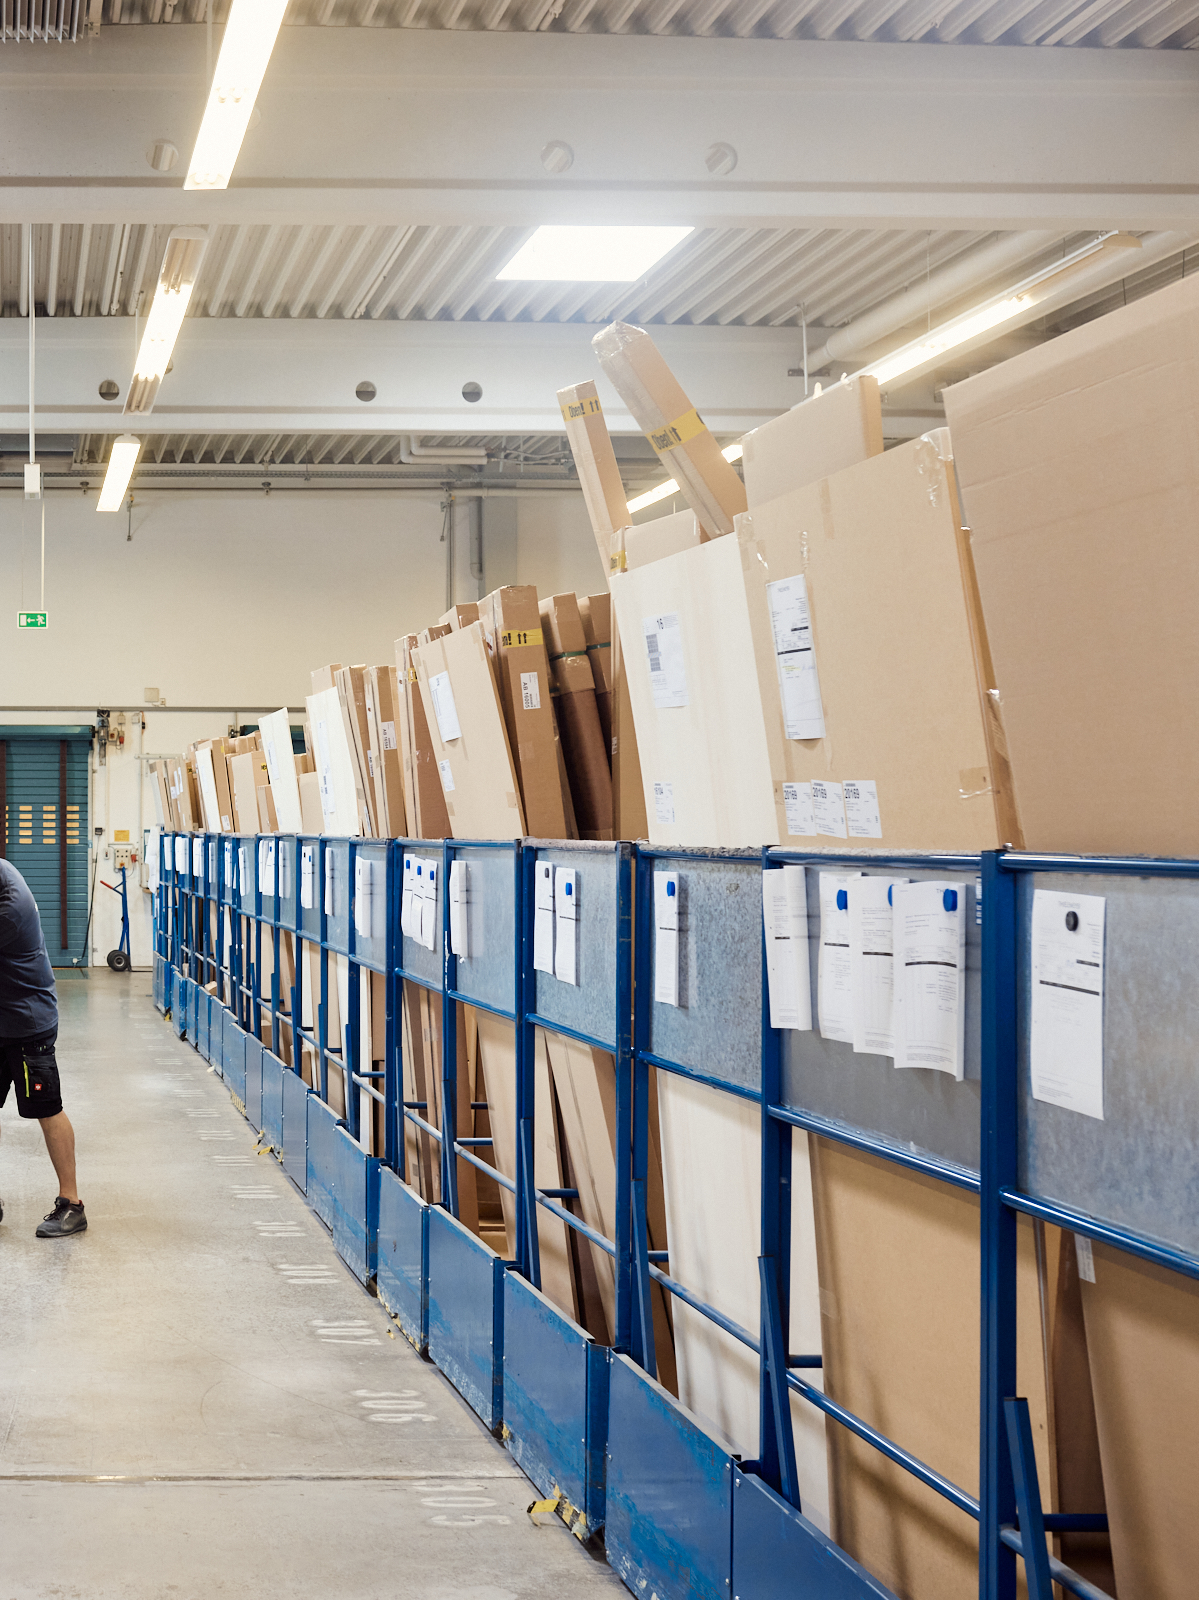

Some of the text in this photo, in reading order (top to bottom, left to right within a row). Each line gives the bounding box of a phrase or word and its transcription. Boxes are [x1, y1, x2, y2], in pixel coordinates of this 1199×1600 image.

[568, 402, 586, 418] Oben!
[230, 1184, 282, 1200] 310
[252, 1220, 308, 1237] 309
[276, 1263, 342, 1285] 308
[310, 1319, 383, 1346] 307
[353, 1388, 438, 1423] 306
[411, 1481, 512, 1528] 305
